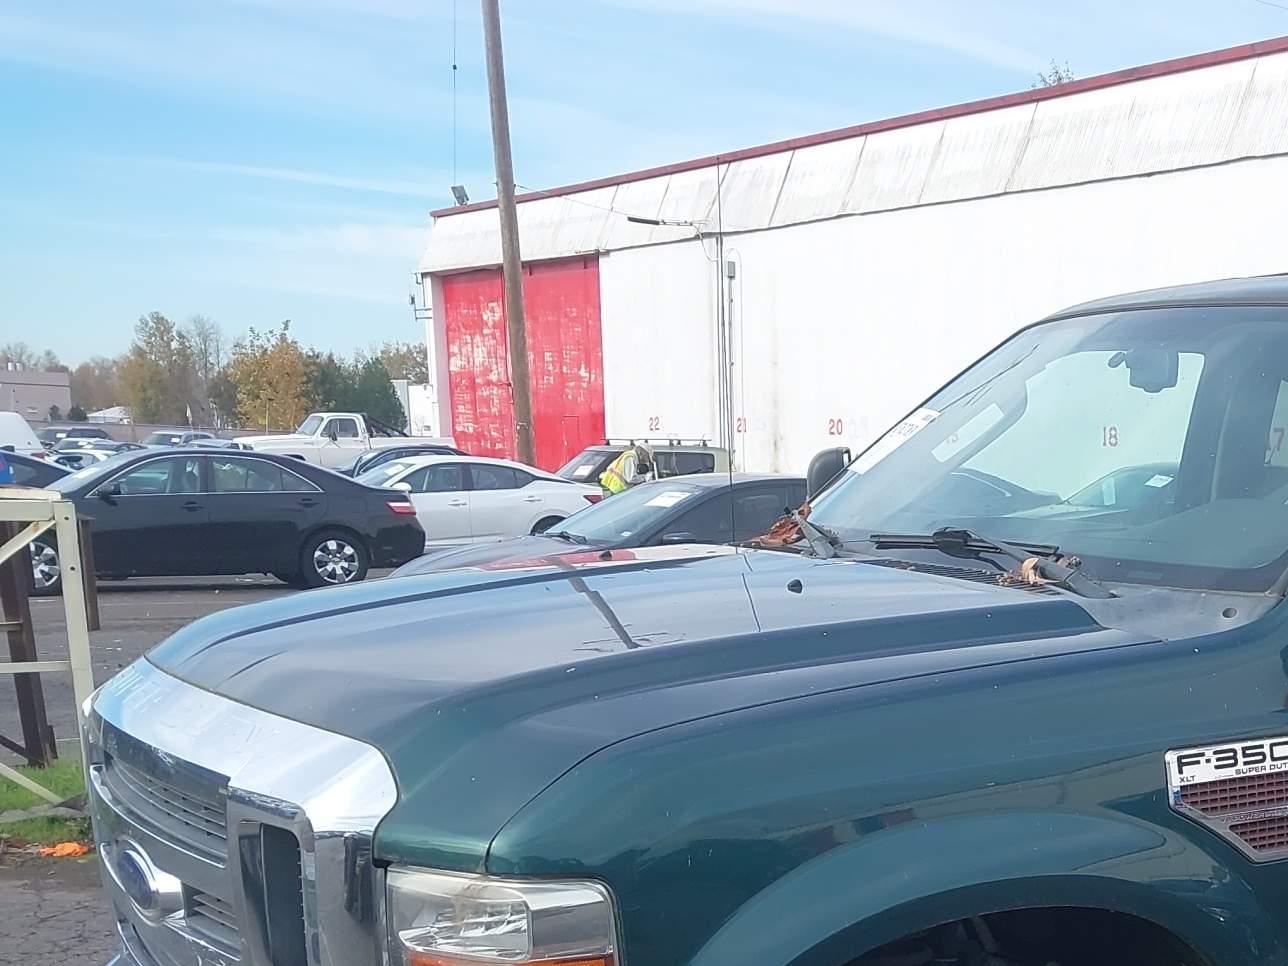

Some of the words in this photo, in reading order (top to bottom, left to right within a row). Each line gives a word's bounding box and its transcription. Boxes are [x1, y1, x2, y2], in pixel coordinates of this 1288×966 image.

[648, 416, 661, 432] 22
[736, 417, 748, 433] 21
[828, 418, 844, 436] 20
[1102, 426, 1119, 448] 18
[1235, 765, 1267, 776] SUPER
[1179, 775, 1196, 783] XLT
